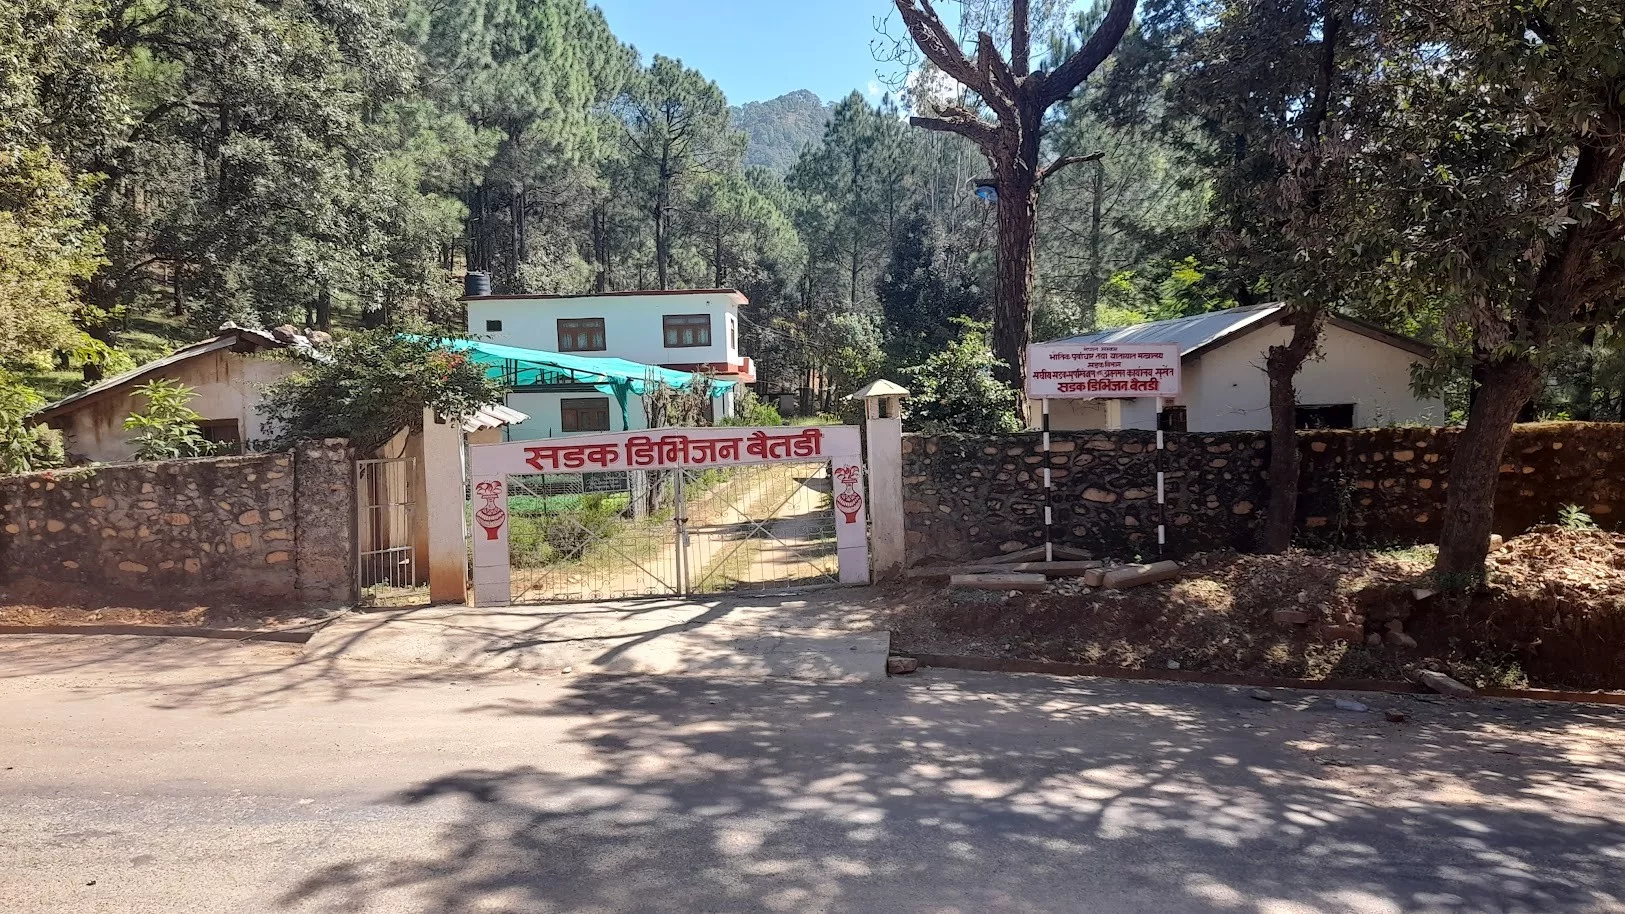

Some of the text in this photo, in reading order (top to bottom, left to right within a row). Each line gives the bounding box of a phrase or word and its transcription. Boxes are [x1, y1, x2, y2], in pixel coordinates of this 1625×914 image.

[1095, 352, 1108, 360] तथा
[1110, 352, 1136, 360] यातायात
[1057, 382, 1087, 393] सडक
[1087, 378, 1129, 392] डिभिजन
[524, 428, 825, 471] सडक डिभिजन बैतडी
